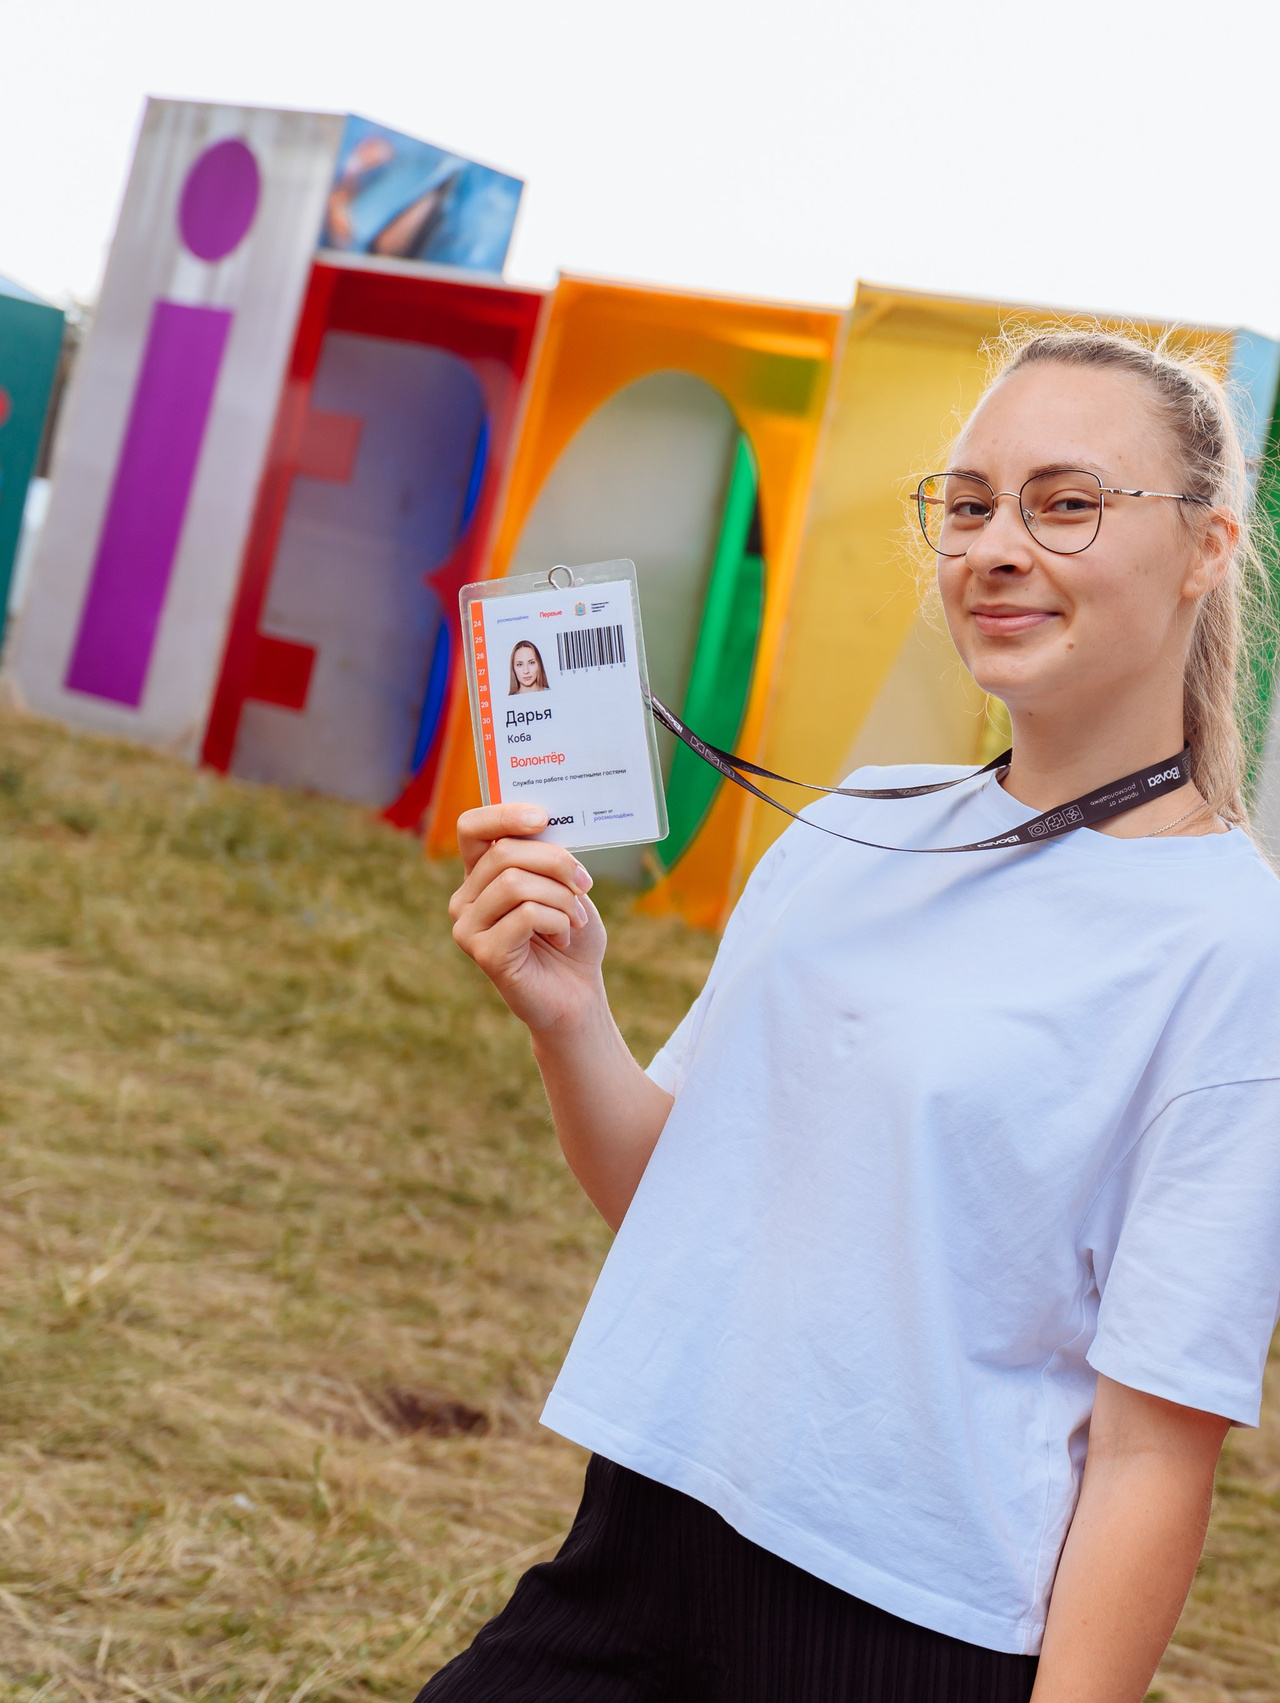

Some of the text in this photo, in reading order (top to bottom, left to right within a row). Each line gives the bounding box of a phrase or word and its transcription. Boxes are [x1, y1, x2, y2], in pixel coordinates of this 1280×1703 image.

[505, 708, 552, 728] Дарья
[507, 733, 532, 744] Коба
[510, 751, 565, 768] Волонтёр
[512, 777, 534, 787] Служба
[543, 775, 564, 785] работе
[569, 772, 602, 780] почетными
[1147, 766, 1181, 788] iВолга
[547, 816, 574, 827] олга
